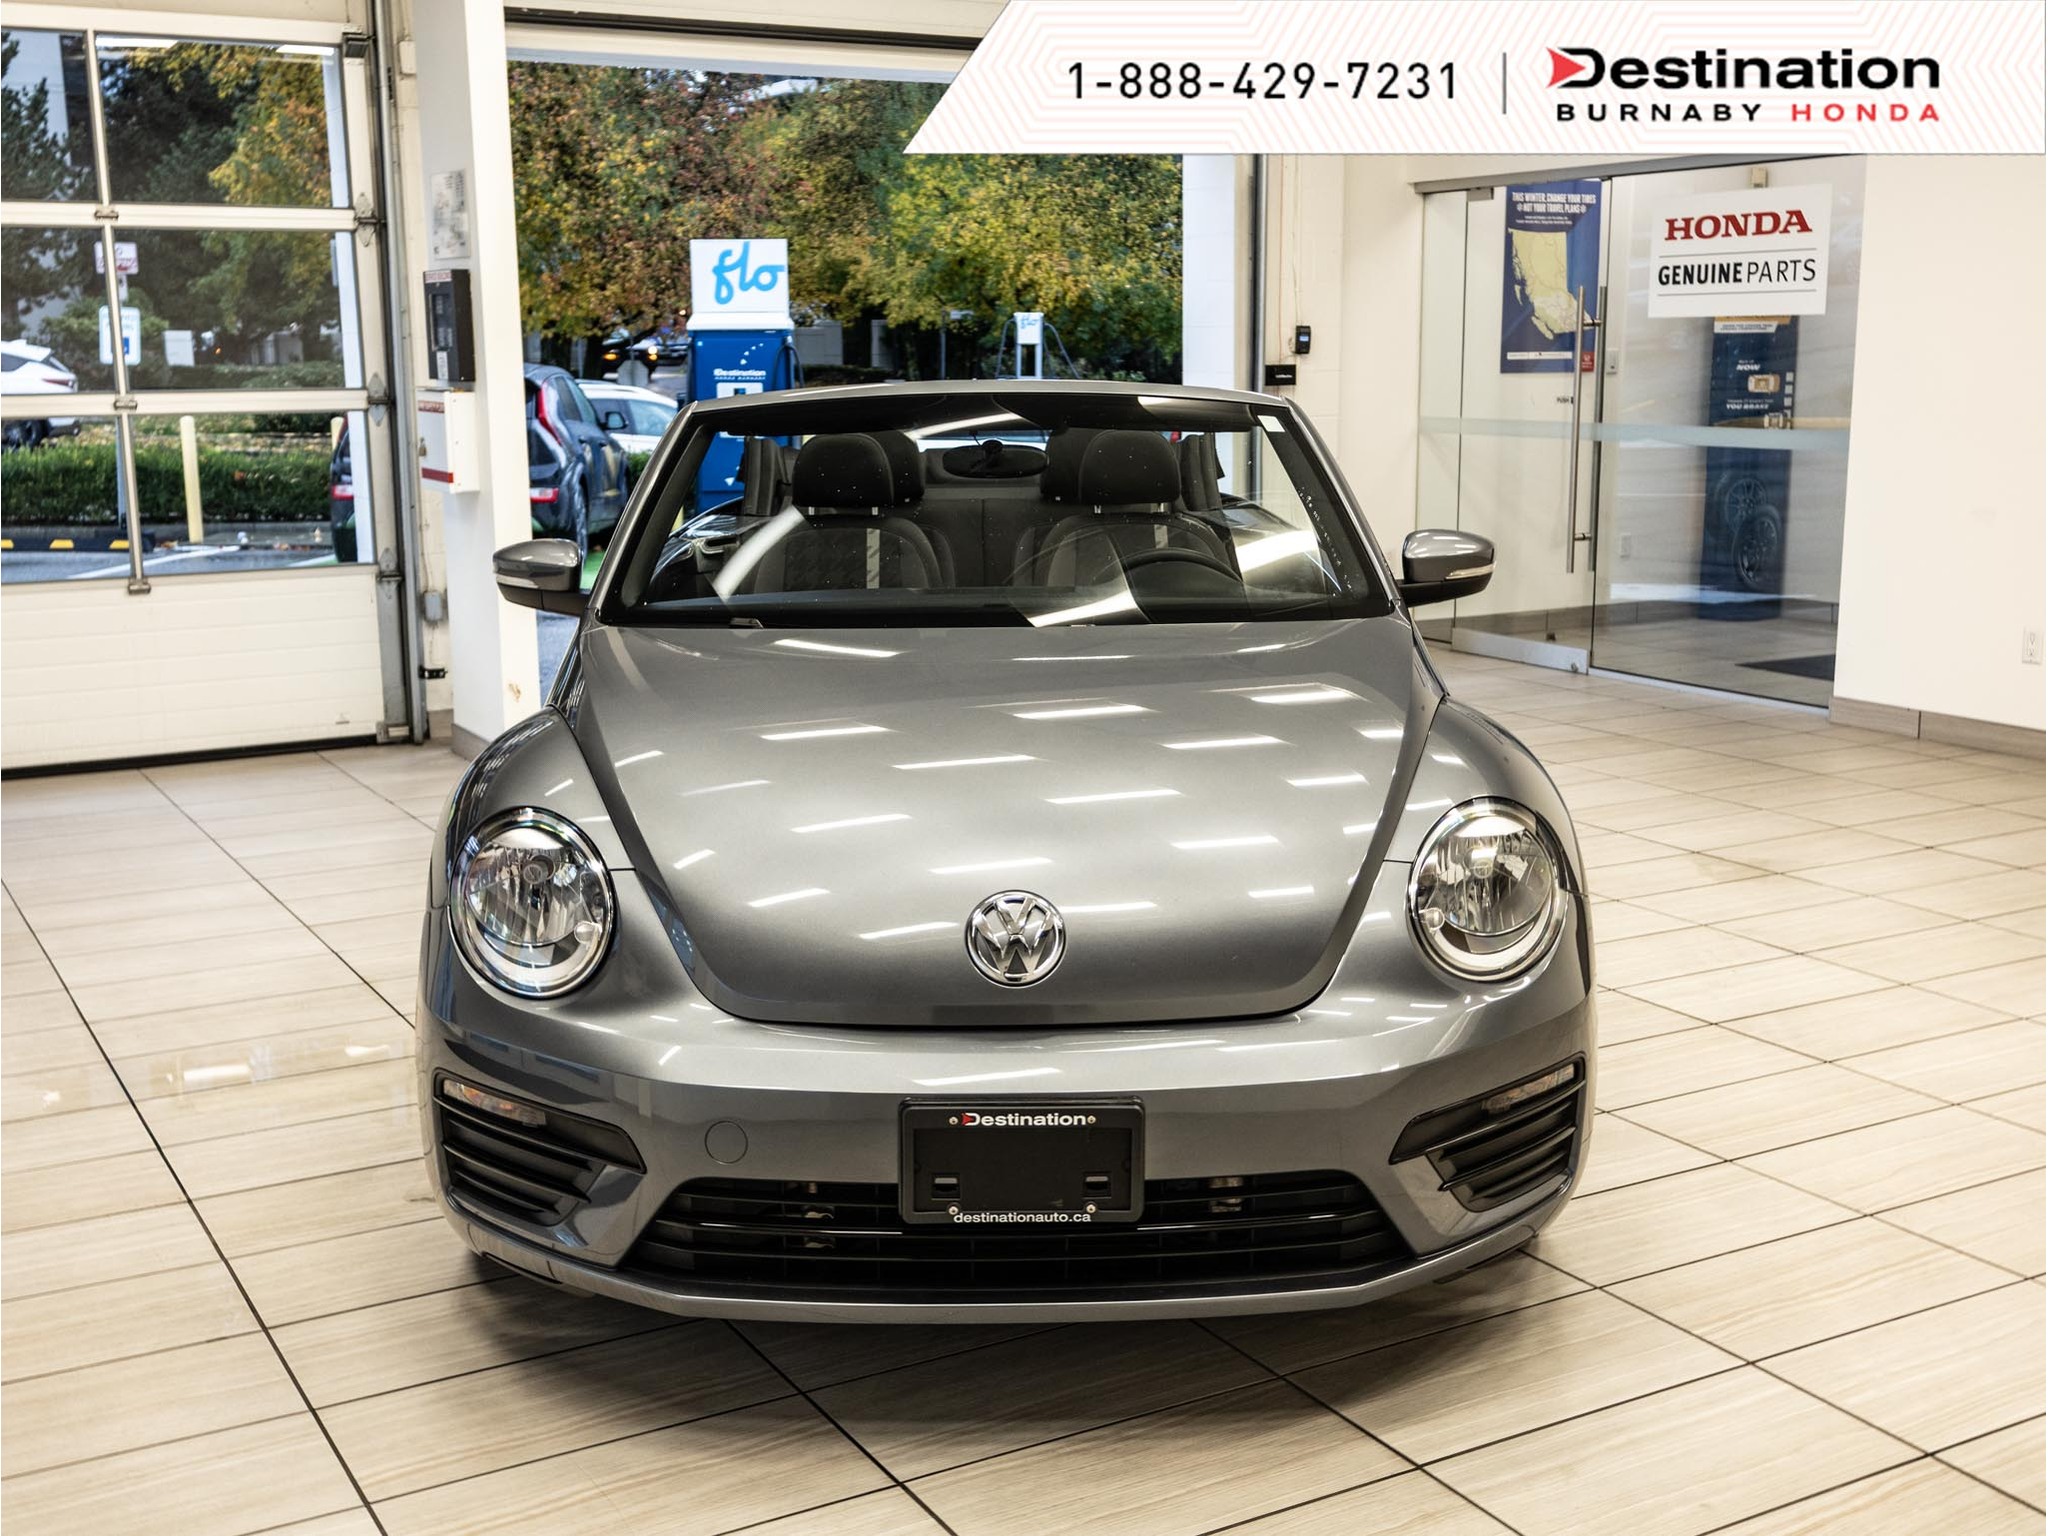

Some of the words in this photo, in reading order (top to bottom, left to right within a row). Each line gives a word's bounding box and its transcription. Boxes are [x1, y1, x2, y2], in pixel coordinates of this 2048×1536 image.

[1512, 192, 1524, 201] THIS
[1546, 192, 1567, 203] CHANGE
[1567, 193, 1581, 203] YOUR
[1523, 203, 1533, 212] NOT
[1533, 203, 1546, 213] YOUR
[1546, 203, 1564, 213] TRAVEL
[1564, 204, 1580, 213] PLANS
[1664, 209, 1813, 241] HONDA
[712, 241, 785, 305] flo
[1658, 262, 1743, 286] GENUINE
[1747, 258, 1816, 283] PARTS
[961, 1112, 1087, 1126] Destination
[953, 1211, 1092, 1224] destinationauto.ca
